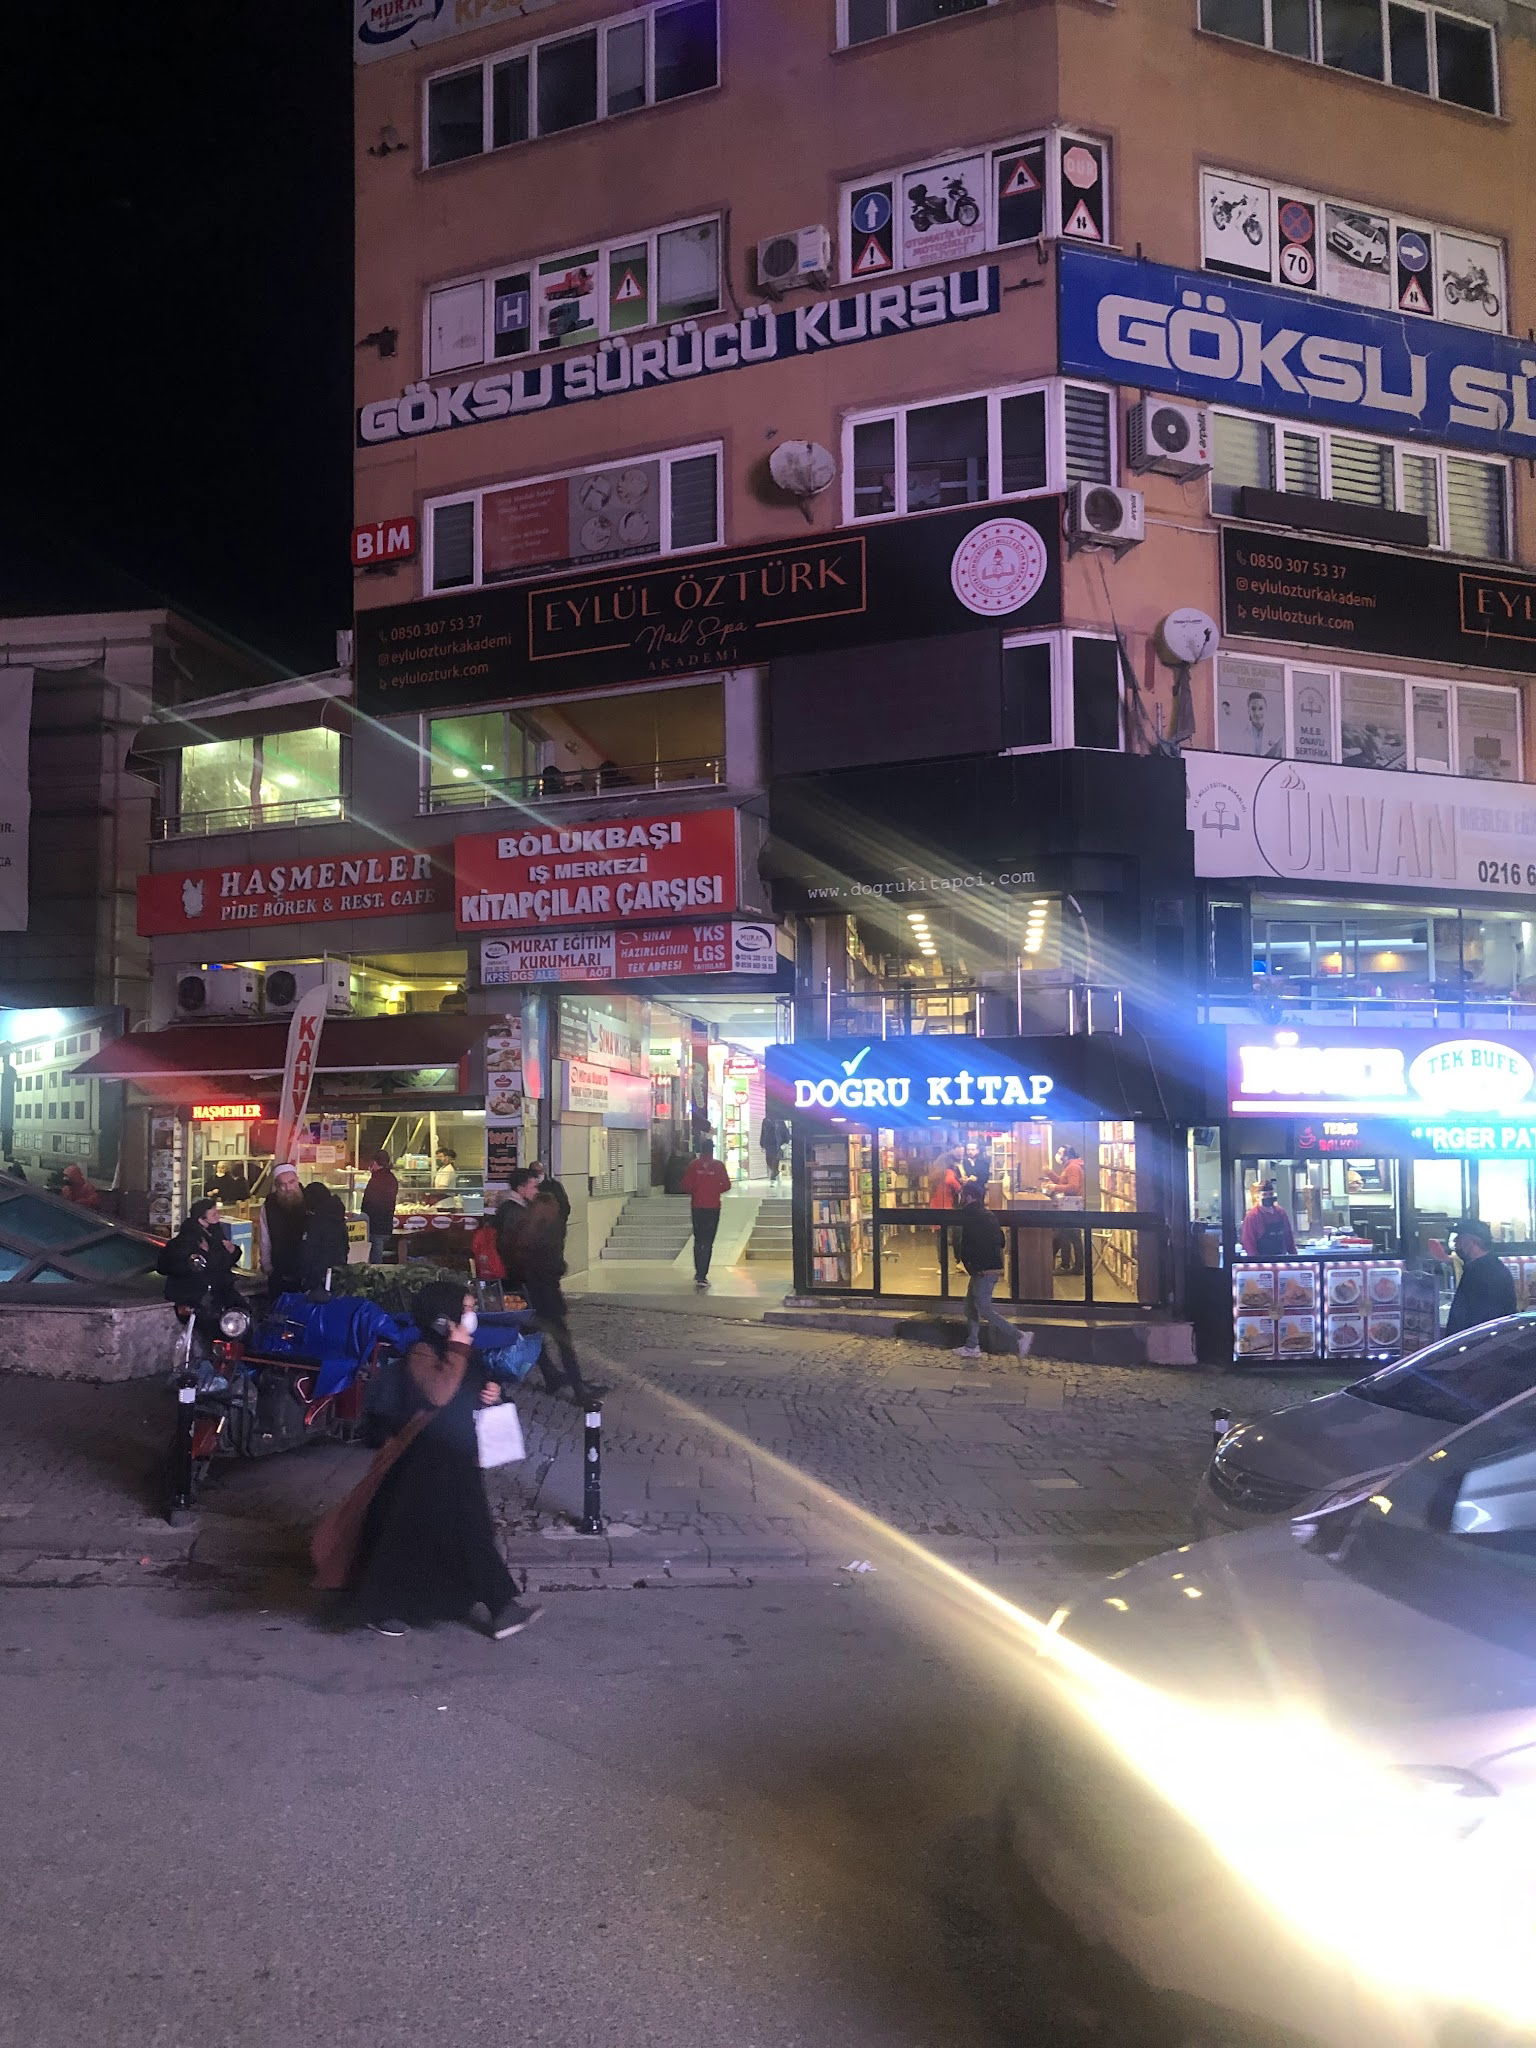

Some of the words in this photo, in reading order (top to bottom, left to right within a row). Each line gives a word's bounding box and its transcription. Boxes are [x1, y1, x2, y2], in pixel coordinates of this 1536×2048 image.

[1287, 253, 1308, 275] 70
[502, 296, 523, 328] H
[360, 365, 552, 443] GÖKSU
[564, 303, 778, 401] SÜRÜCÜ
[795, 265, 989, 351] KURSU
[1097, 290, 1428, 420] GÖKSU
[355, 522, 411, 560] BİM
[1249, 552, 1283, 571] 0850
[1285, 554, 1309, 574] 307
[1312, 562, 1328, 578] 53
[1331, 565, 1346, 580] 37
[546, 584, 662, 632] EYLÜL
[674, 555, 848, 610] ÖZTÜRK
[1250, 579, 1376, 608] eylulozturkakademi
[390, 623, 421, 642] 0850
[424, 620, 446, 639] 307
[449, 618, 465, 635] 53
[466, 613, 483, 632] 37
[1251, 604, 1354, 632] eylulozturk.com
[391, 633, 513, 664] eylulozturkakademi
[391, 661, 489, 687] eylulozturk.com
[220, 853, 432, 898] HAŞMENLER
[554, 852, 648, 880] MERKEZİ
[1478, 860, 1521, 886] 0216
[461, 882, 611, 923] KİTAPÇILAR
[616, 874, 723, 917] ÇARŞISI
[807, 870, 1036, 900] www.dogrukitapci.com
[220, 900, 259, 921] PİDE
[323, 898, 333, 913] &
[340, 893, 384, 911] REST.
[390, 888, 435, 906] CAFE
[511, 938, 557, 954] MURAT
[563, 933, 611, 951] EĞİTİM
[693, 925, 725, 942] YKS
[520, 952, 601, 970] KURUMLARI
[693, 944, 725, 962] LGS
[486, 971, 510, 983] KPSS
[511, 970, 534, 981] DGS
[628, 962, 645, 973] TEK
[1427, 1050, 1464, 1074] TEK
[926, 1070, 1054, 1106] KİTAP
[192, 1104, 262, 1121] HAŞMENLER
